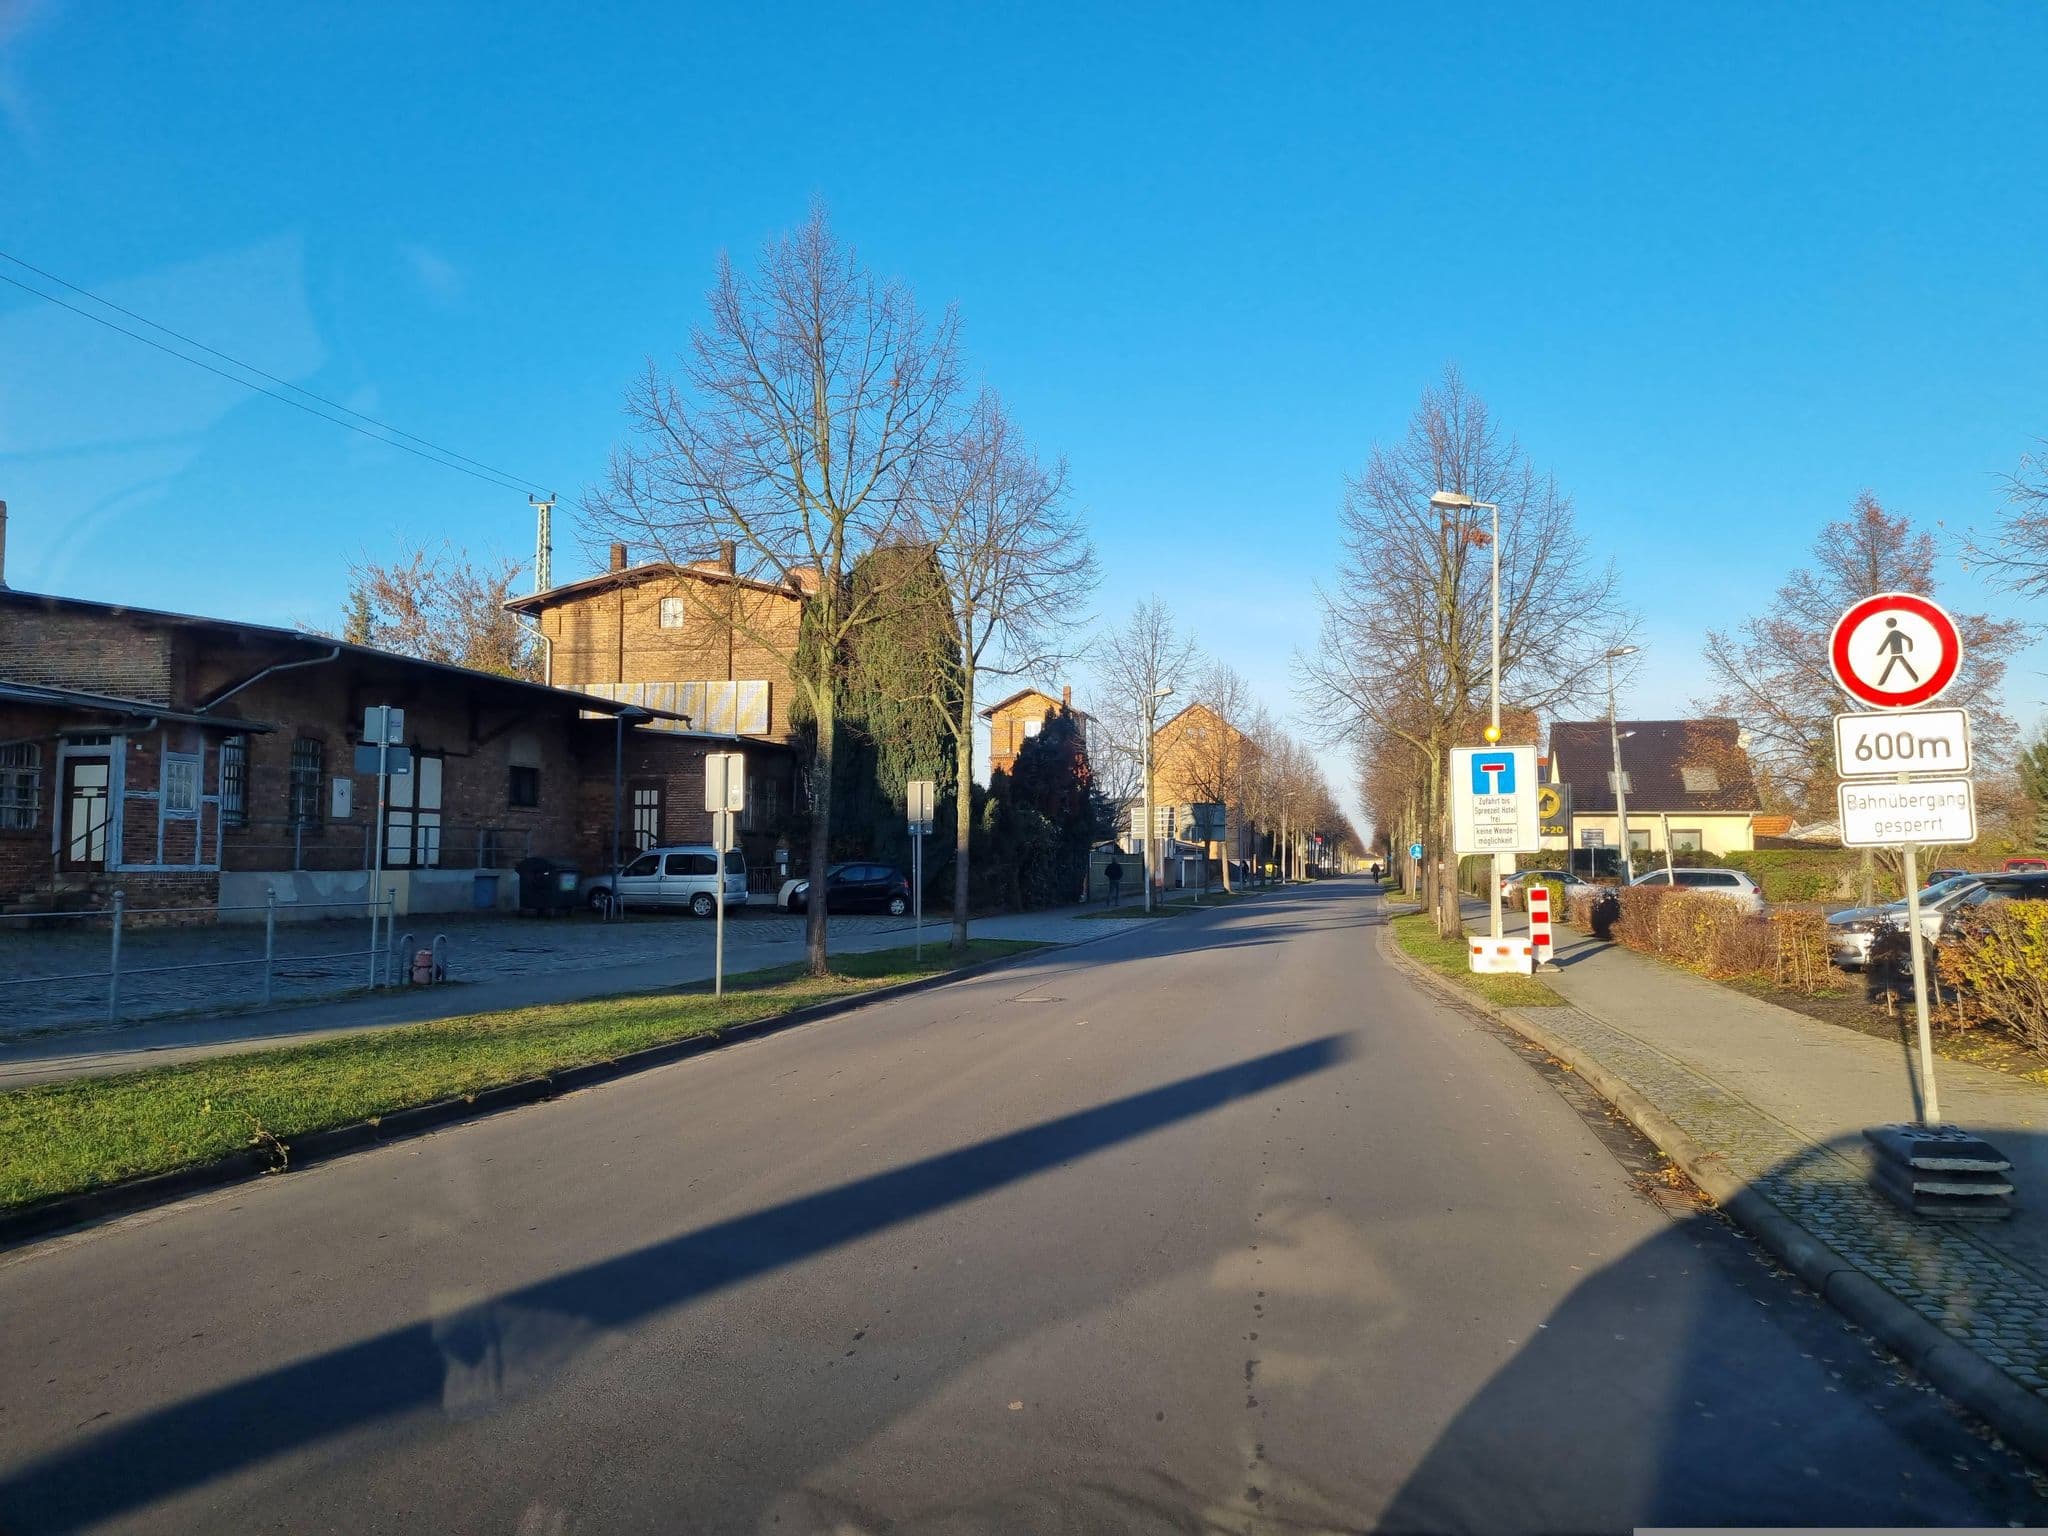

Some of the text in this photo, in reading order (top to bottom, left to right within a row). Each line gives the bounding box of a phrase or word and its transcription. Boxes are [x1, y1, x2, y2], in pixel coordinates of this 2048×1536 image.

[1855, 731, 1951, 761] 600m
[1478, 797, 1500, 805] Zufahrt
[1847, 792, 1966, 811] Bahnübergang
[1501, 806, 1516, 814] Hotel
[1476, 827, 1492, 835] keine
[1874, 816, 1943, 837] gesperrt
